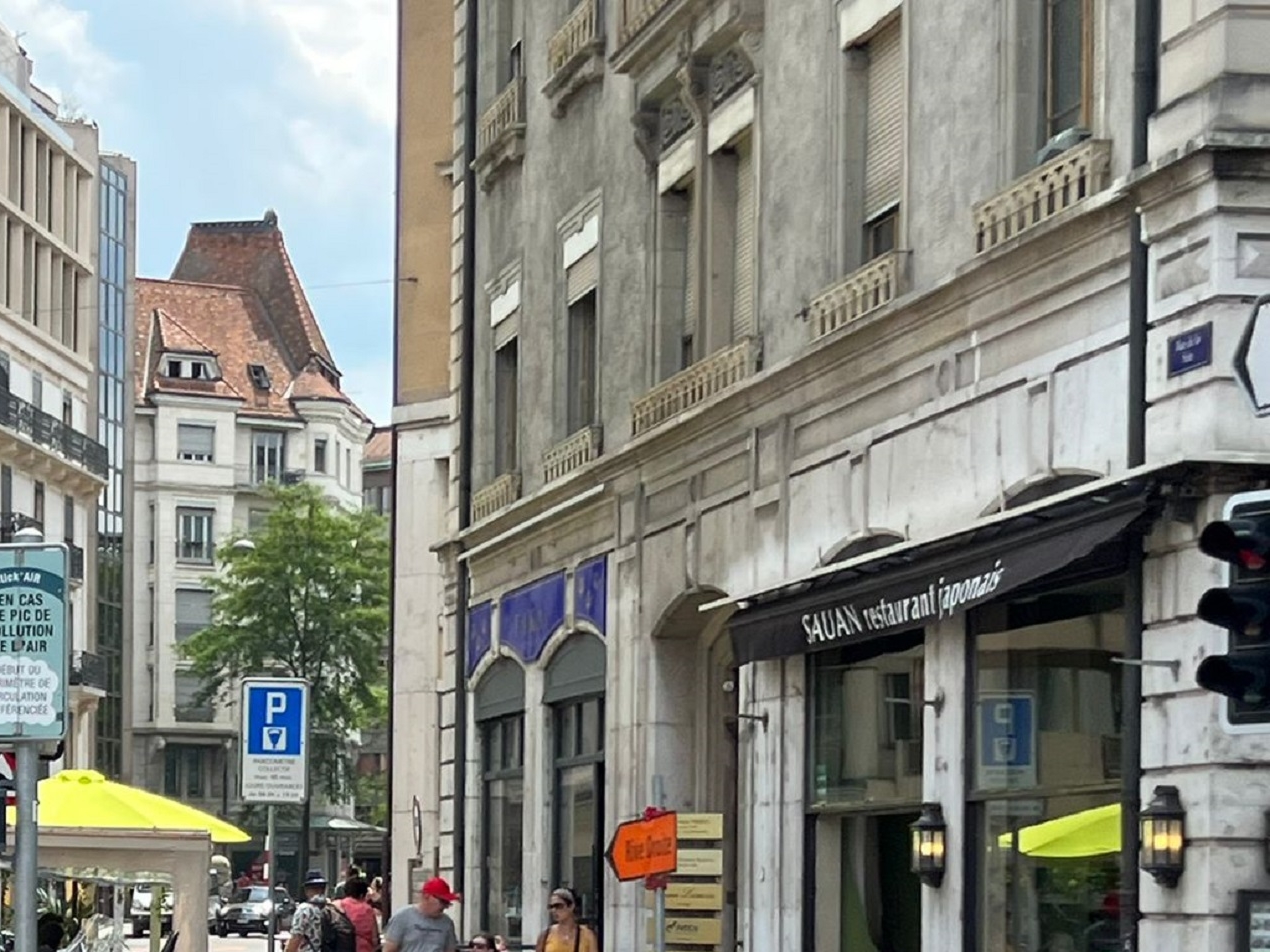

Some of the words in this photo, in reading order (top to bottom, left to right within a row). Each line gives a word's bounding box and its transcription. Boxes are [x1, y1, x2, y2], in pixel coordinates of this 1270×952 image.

[19, 593, 44, 606] CAS
[801, 604, 863, 645] SAUAN
[862, 584, 936, 631] restaurant
[937, 559, 1005, 620] japonais
[10, 609, 31, 622] PIC
[35, 609, 51, 622] DE
[266, 691, 287, 725] P
